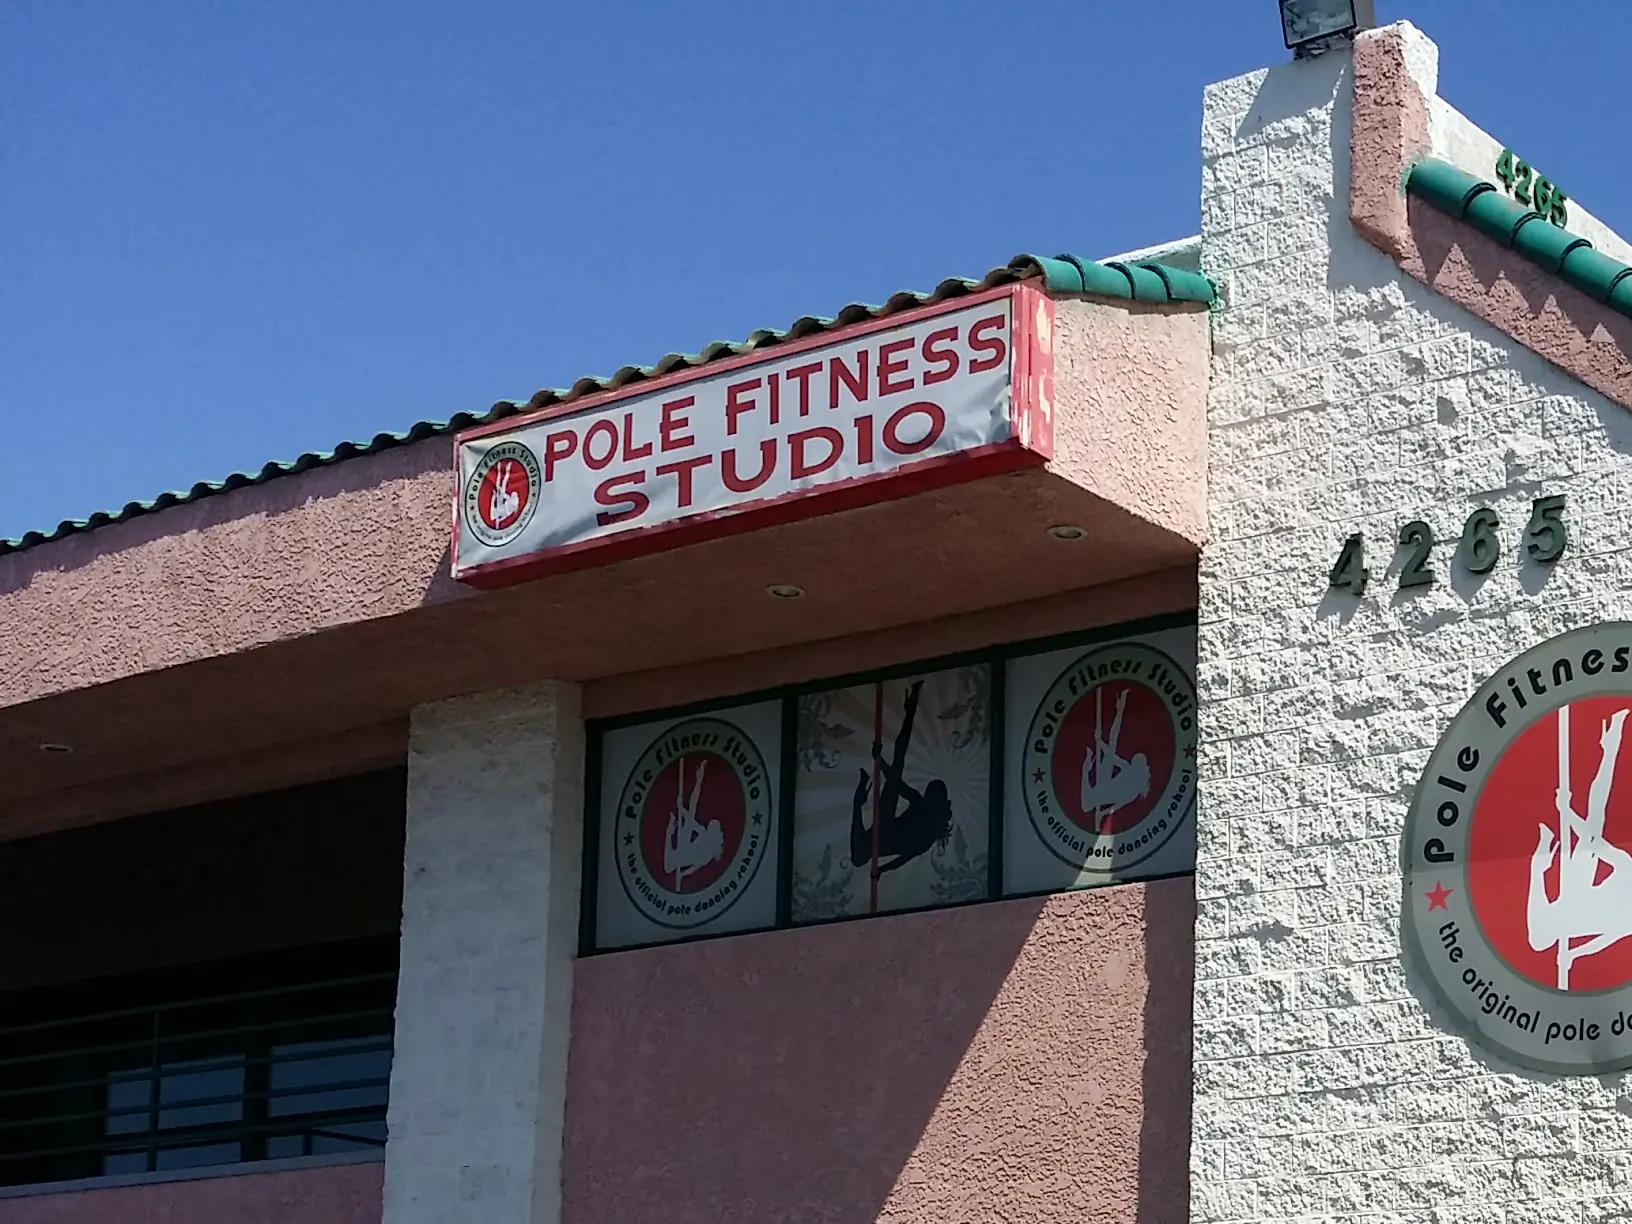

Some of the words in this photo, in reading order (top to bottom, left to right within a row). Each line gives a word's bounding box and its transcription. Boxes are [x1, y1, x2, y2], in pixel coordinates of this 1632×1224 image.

[1496, 149, 1567, 229] 4265
[544, 396, 695, 483] POLE
[726, 313, 1006, 436] FITNESS
[469, 472, 483, 500] Pole
[484, 447, 516, 468] Fitness
[519, 449, 537, 487] Studio
[595, 401, 946, 526] STUDIO
[1329, 494, 1567, 596] 4265
[1034, 699, 1065, 754] Pole
[1068, 659, 1142, 696] Fitness
[1148, 663, 1193, 731] Studio
[625, 769, 653, 820] Pole
[656, 732, 720, 766] Fitness
[724, 736, 761, 800] Studio
[1038, 790, 1049, 814] the
[1047, 816, 1086, 853] official
[1086, 845, 1114, 859] pole
[1118, 819, 1167, 856] dancing
[1167, 768, 1193, 818] school
[1423, 745, 1480, 863] Pole
[627, 853, 637, 875] the
[635, 877, 666, 912] official
[667, 903, 692, 915] pole
[695, 881, 738, 913] dancing
[738, 834, 760, 880] school
[1438, 920, 1464, 964] the
[1462, 967, 1541, 1034] original
[1544, 1017, 1601, 1045] pole
